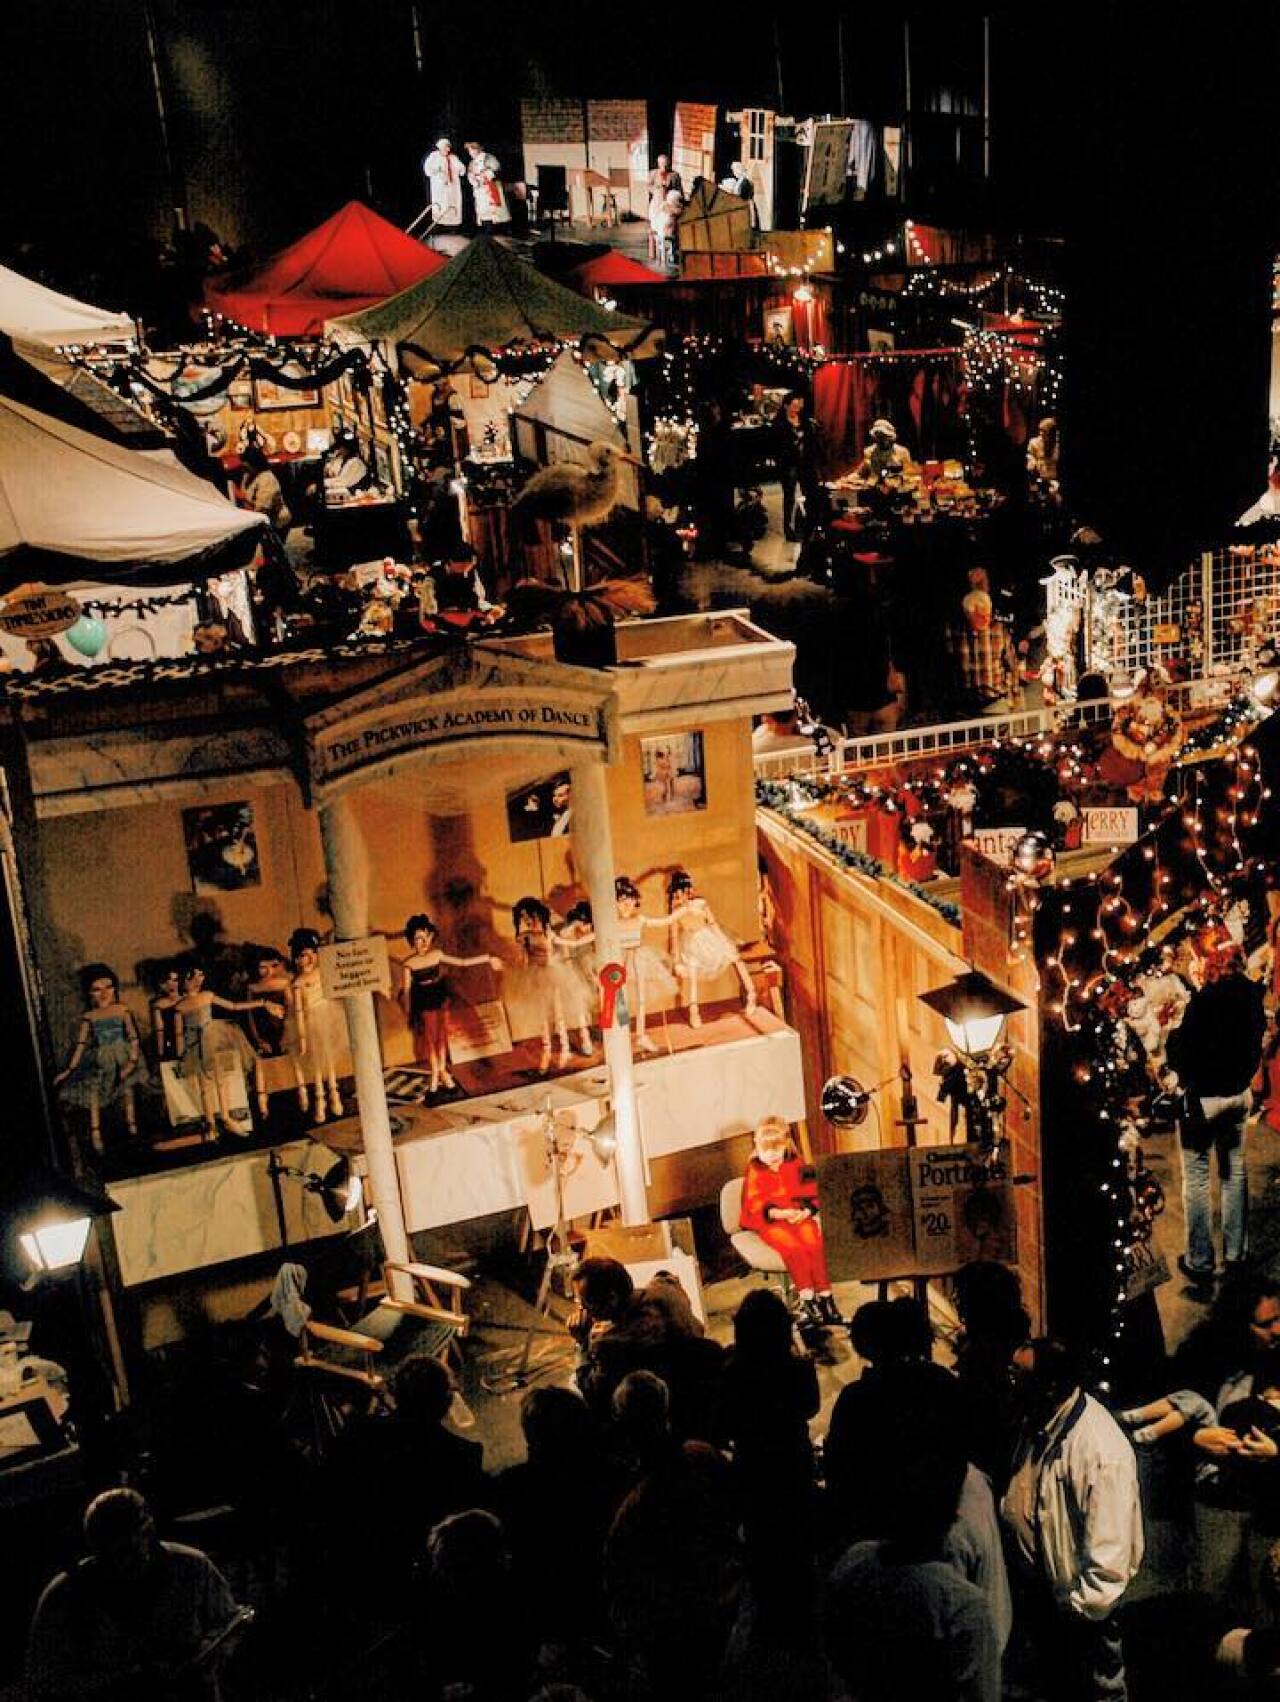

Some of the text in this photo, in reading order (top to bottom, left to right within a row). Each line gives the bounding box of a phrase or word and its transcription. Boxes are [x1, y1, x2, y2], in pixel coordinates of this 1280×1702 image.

[327, 740, 360, 761] THE
[362, 717, 439, 748] PICKWICK
[442, 708, 514, 728] ACADEMY
[542, 707, 591, 726] DANCE
[974, 832, 1016, 853] anta
